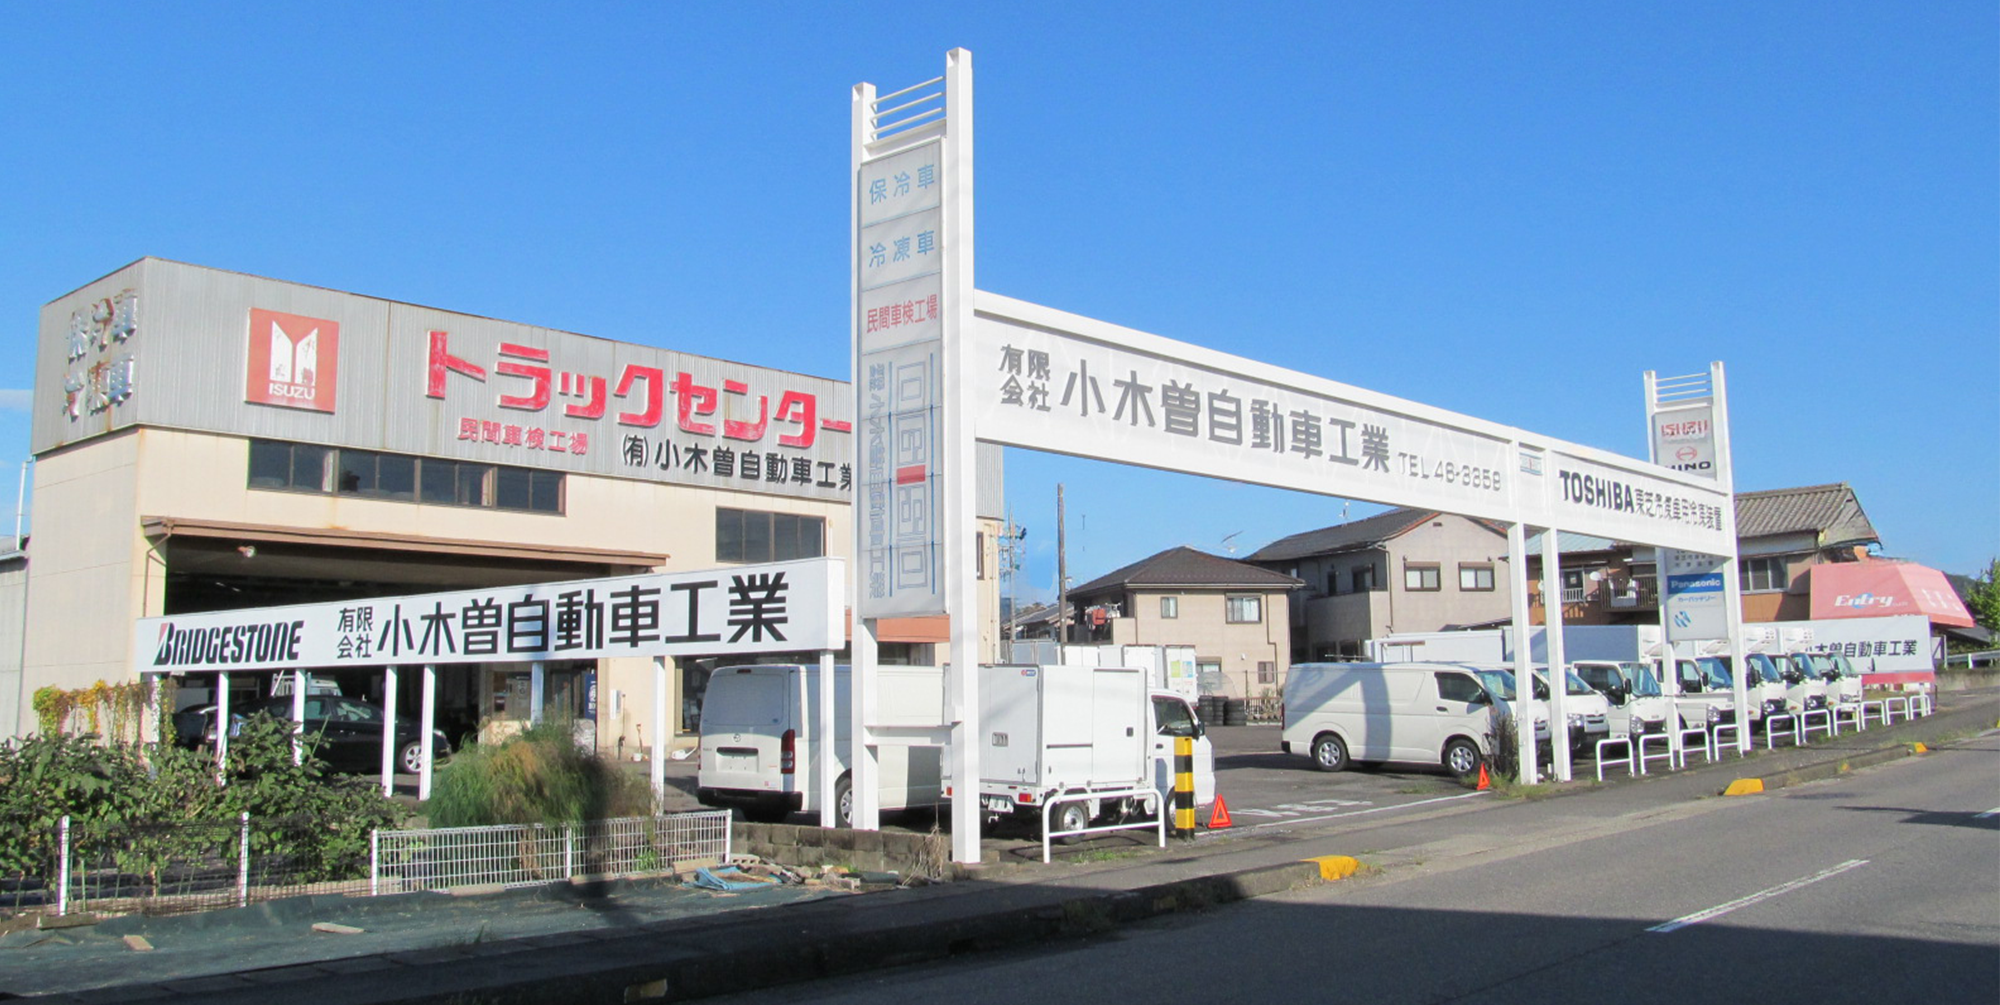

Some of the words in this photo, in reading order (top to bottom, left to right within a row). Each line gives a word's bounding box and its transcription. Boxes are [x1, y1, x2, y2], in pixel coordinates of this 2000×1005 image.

[869, 164, 935, 205] 保冷車
[868, 230, 935, 268] 冷凍車
[867, 294, 938, 333] 民間車検工場
[998, 343, 1051, 381] 有限
[269, 382, 315, 400] ISUZU
[426, 330, 851, 448] トラックセンター
[1000, 374, 1052, 413] 会社
[1060, 359, 1390, 474] 小木曽自動車工業
[1660, 420, 1708, 437] ISUZU
[457, 417, 588, 455] 民間車検工場
[1398, 452, 1430, 479] TEL
[1665, 461, 1711, 471] INO
[1559, 469, 1635, 514] TOSHIBA
[1671, 578, 1721, 589] Panasonic
[1834, 593, 1893, 608] Entry
[337, 606, 373, 633] 有限
[377, 571, 789, 657] 小木曽自動車工業
[153, 620, 304, 666] BRIDGESTONE
[337, 633, 372, 659] 会社
